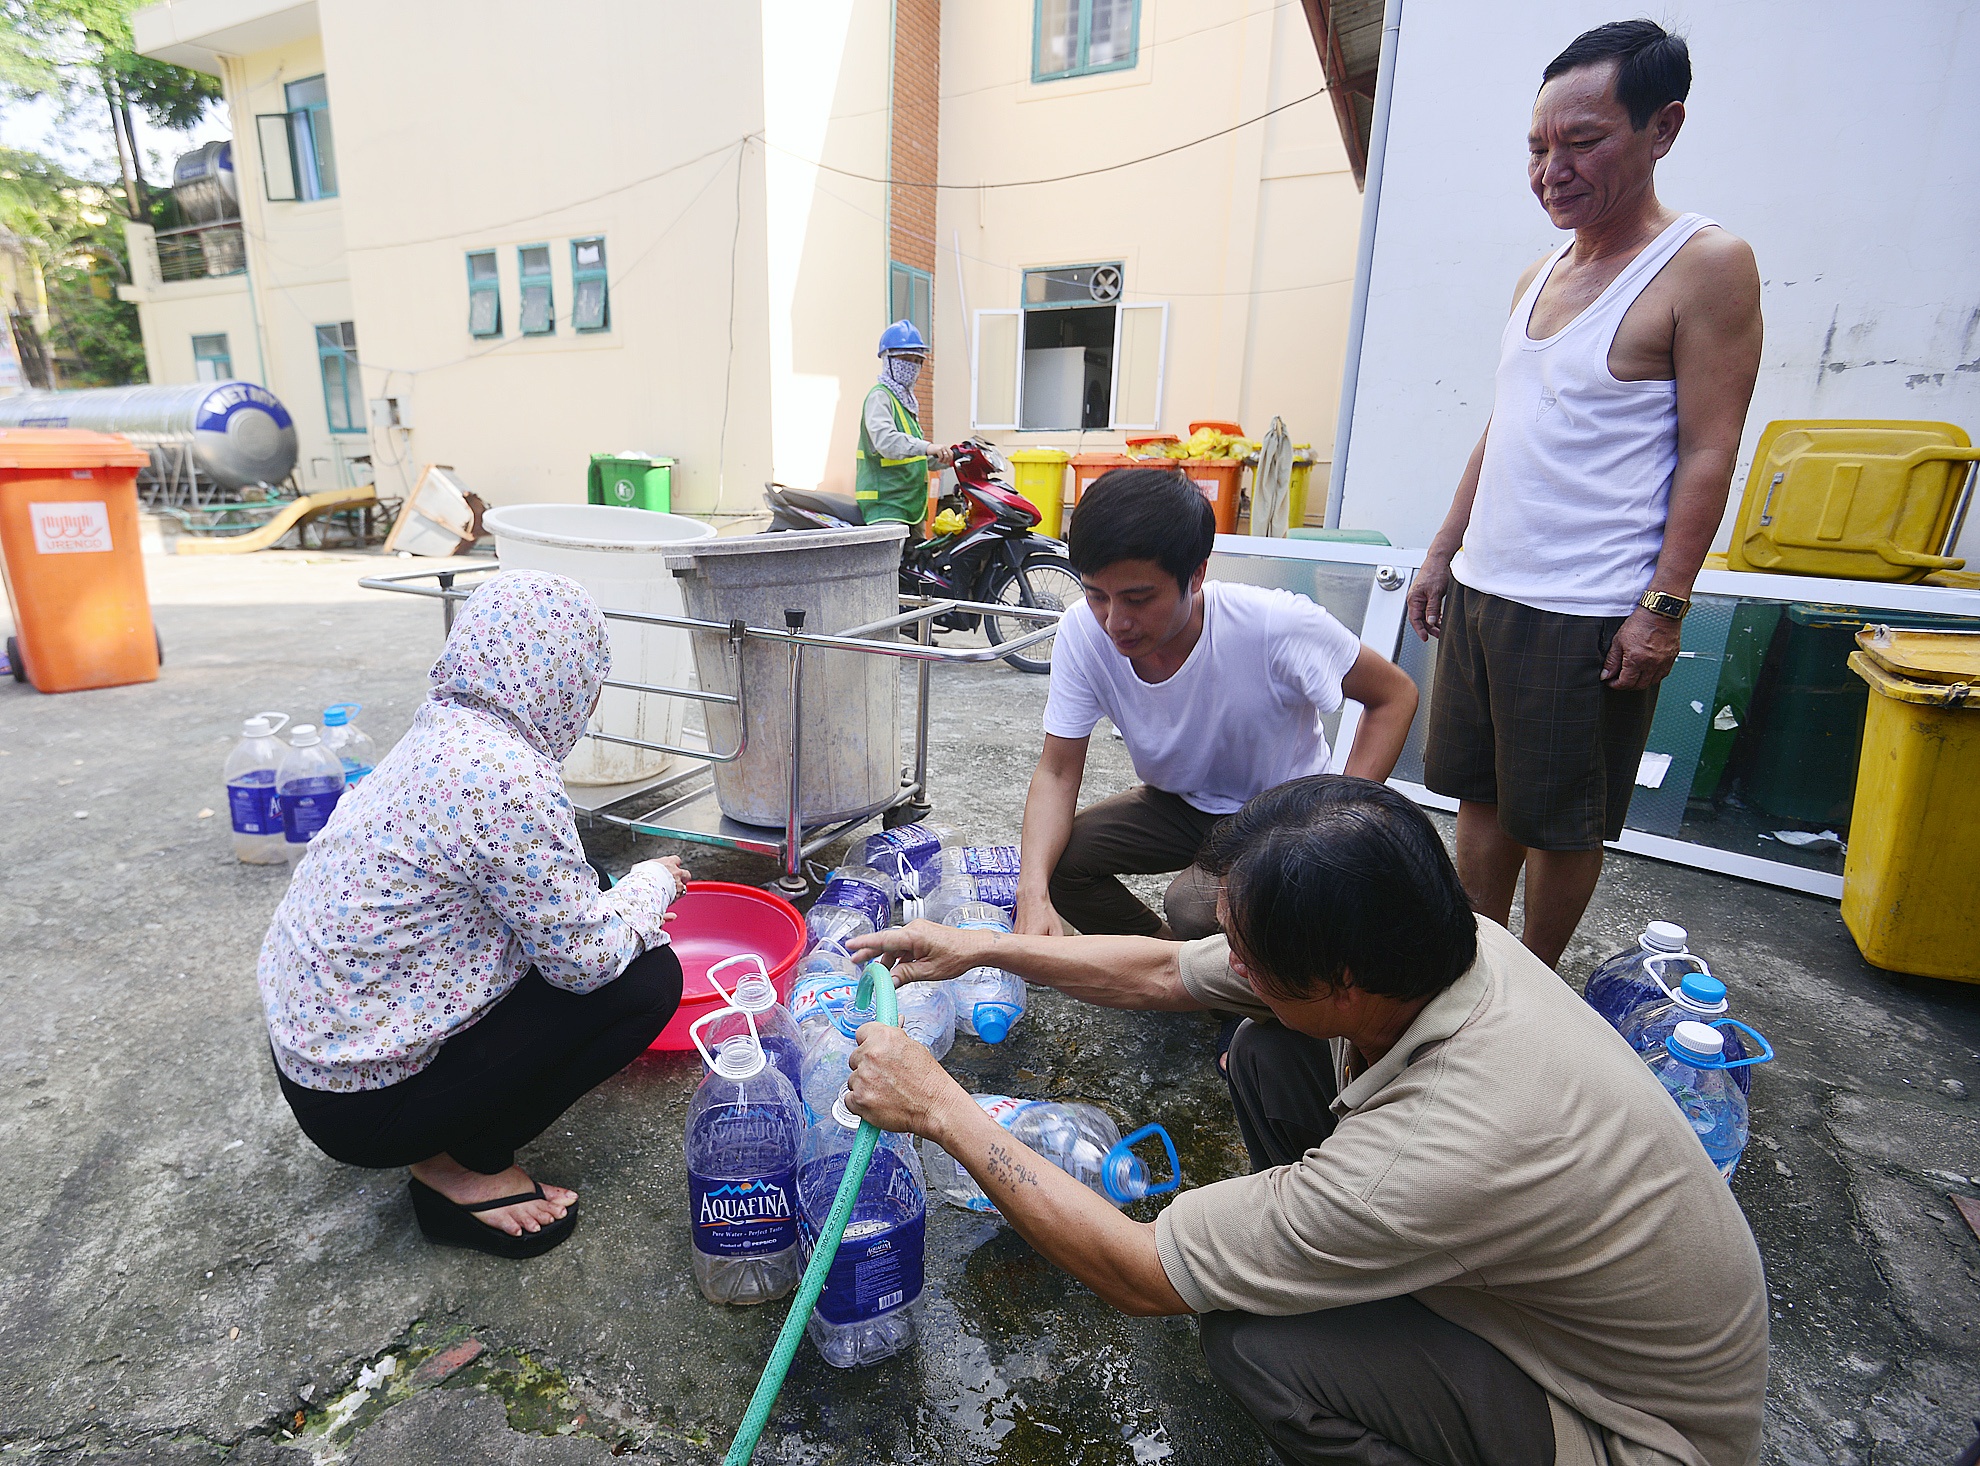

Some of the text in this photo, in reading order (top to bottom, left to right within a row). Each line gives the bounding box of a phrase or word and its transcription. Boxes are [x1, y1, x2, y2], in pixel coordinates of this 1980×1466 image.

[699, 1187, 791, 1225] AQUAFINA
[748, 1228, 768, 1237] Perfect
[769, 1226, 783, 1234] Taste
[751, 1238, 777, 1247] PEPSICO
